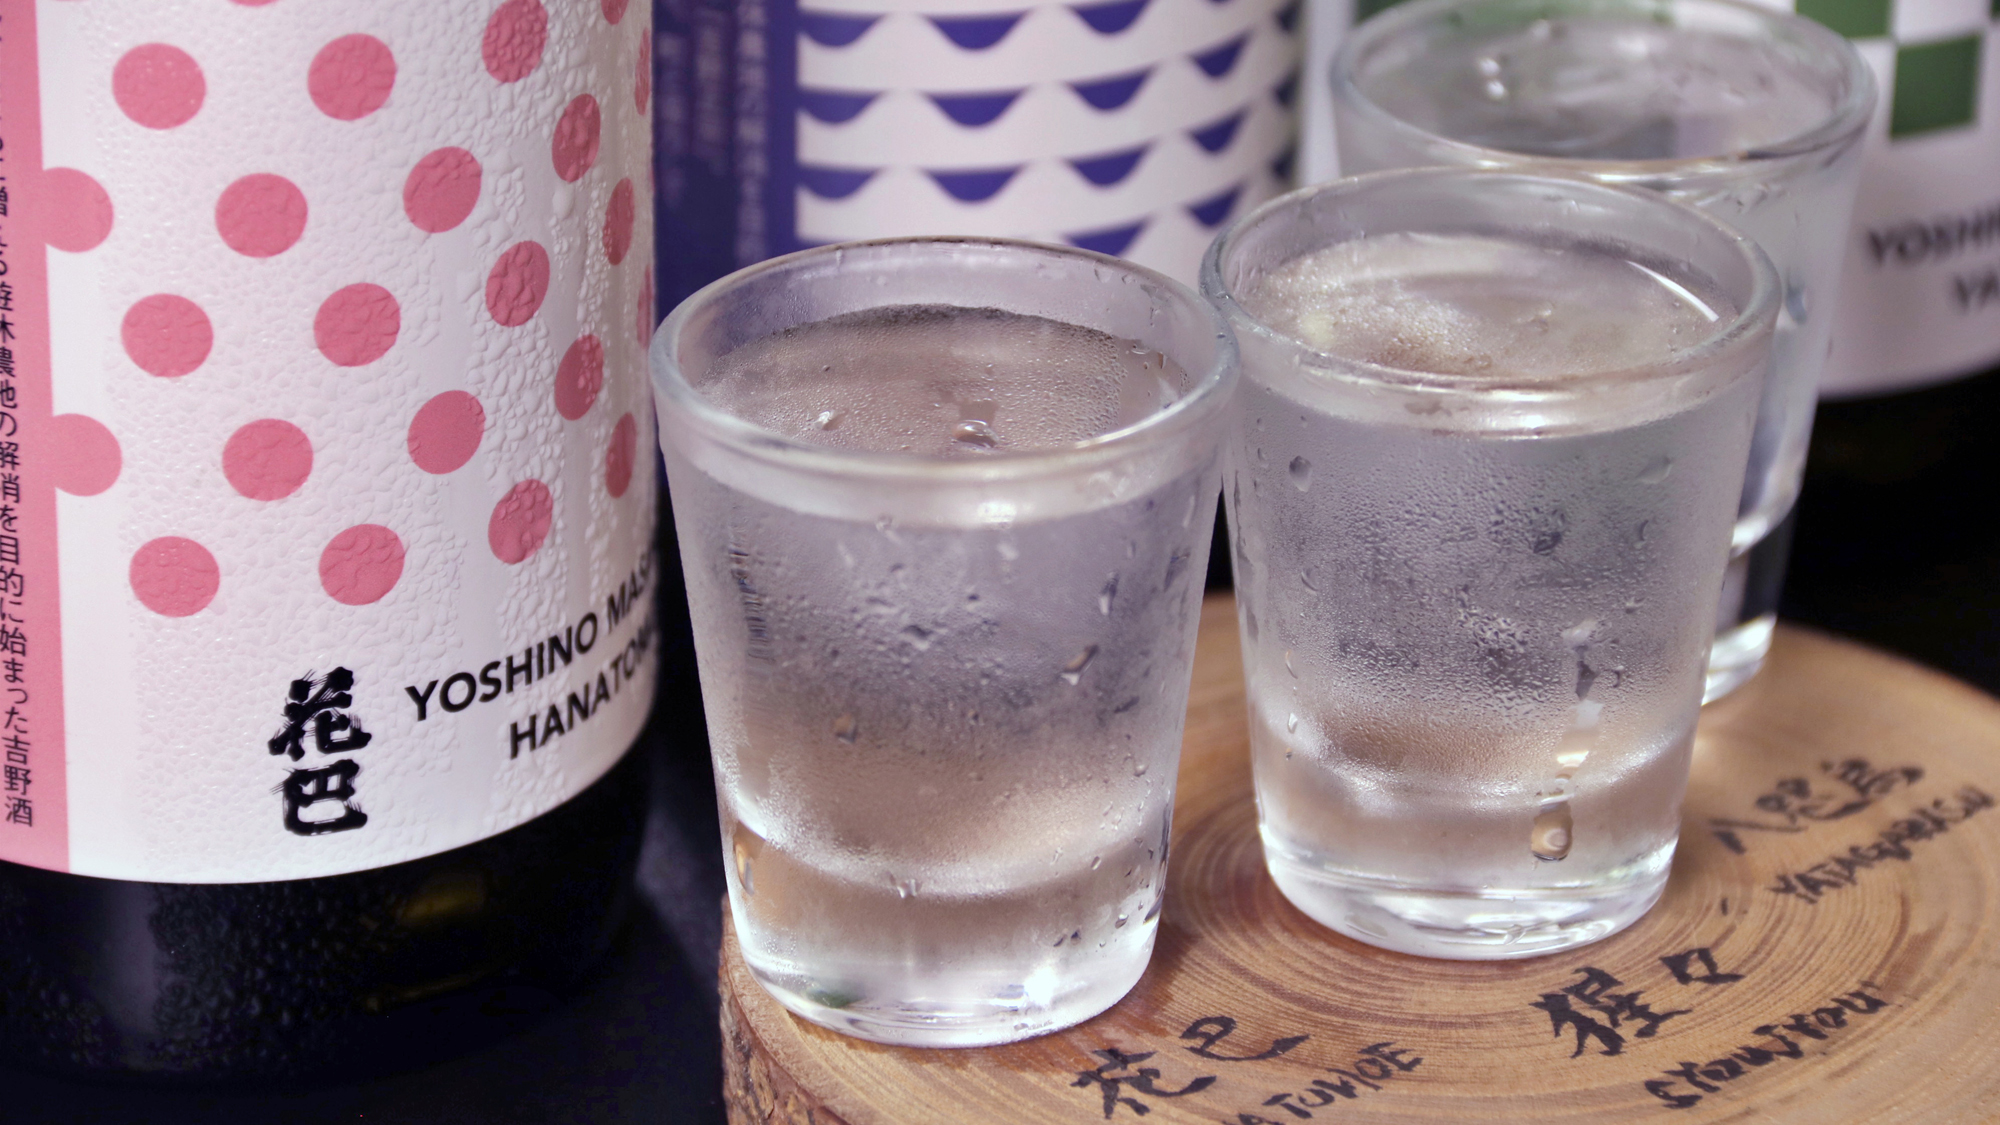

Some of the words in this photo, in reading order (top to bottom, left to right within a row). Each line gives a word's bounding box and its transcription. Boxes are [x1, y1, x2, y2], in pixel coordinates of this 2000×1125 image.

[1866, 203, 2000, 265] YOSHI
[405, 611, 599, 721] YOSHINO
[267, 665, 372, 837] 花巴
[1069, 1015, 1311, 1120] 花巴
